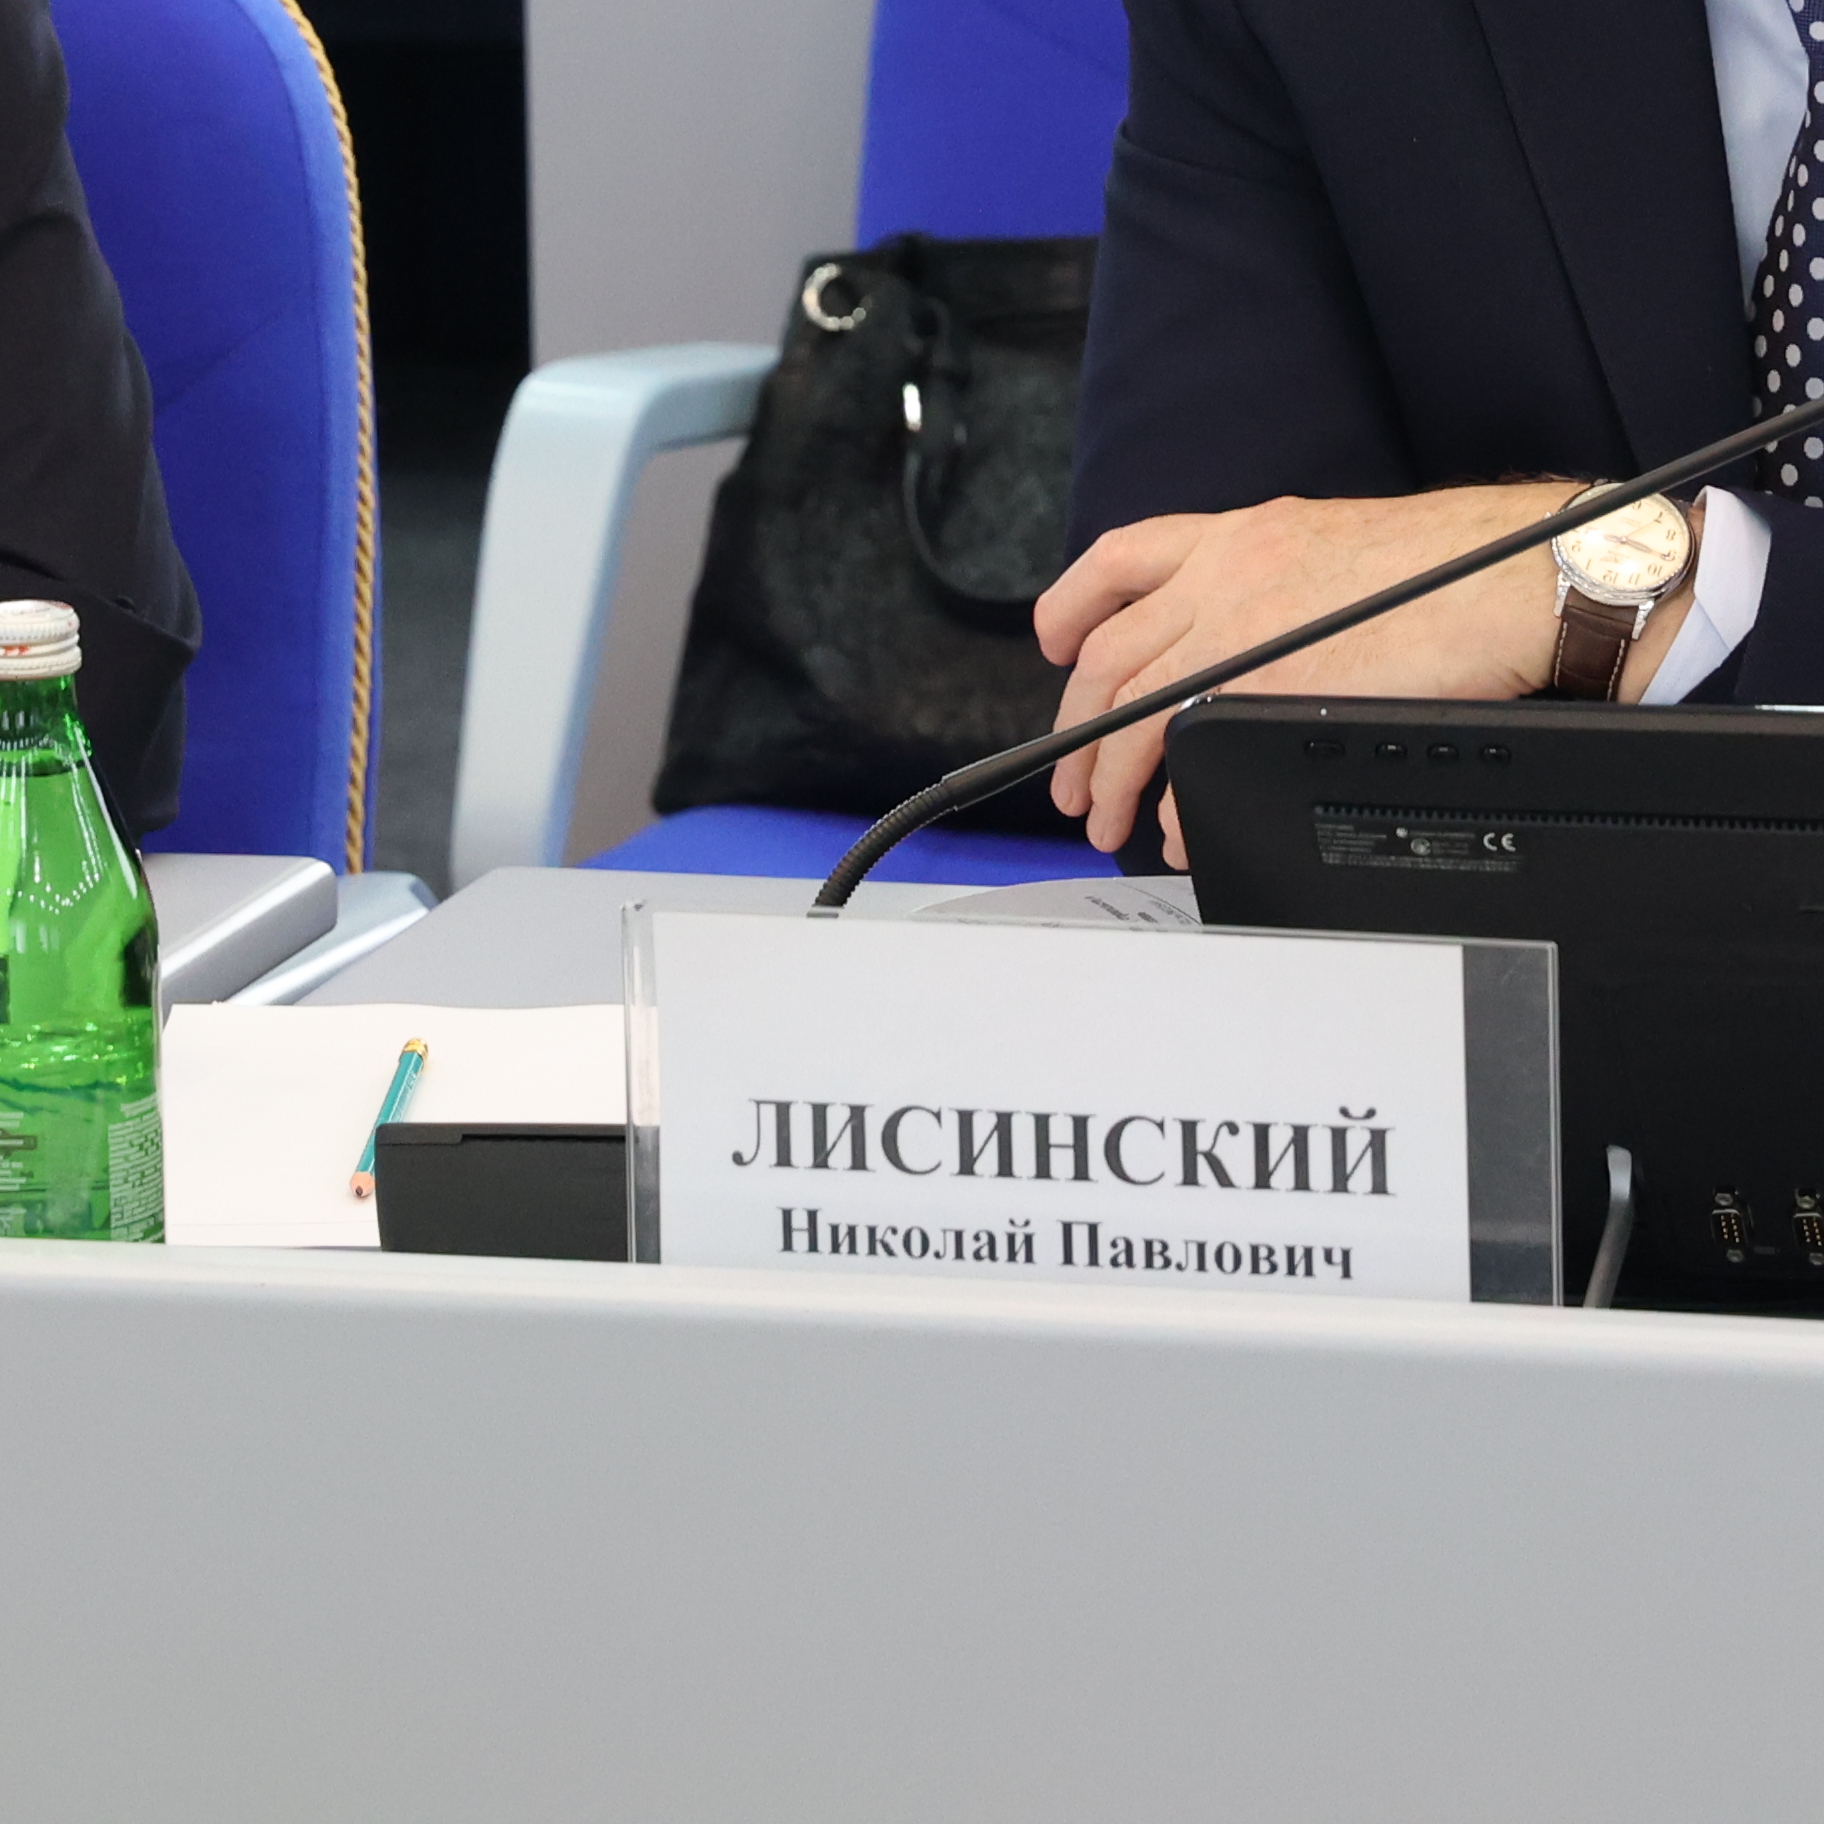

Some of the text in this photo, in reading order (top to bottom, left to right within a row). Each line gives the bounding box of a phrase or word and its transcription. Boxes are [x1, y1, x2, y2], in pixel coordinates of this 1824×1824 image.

[732, 1099, 1397, 1196] ЛИСИНСКИЙ
[778, 1207, 1354, 1280] Николай Павлович
